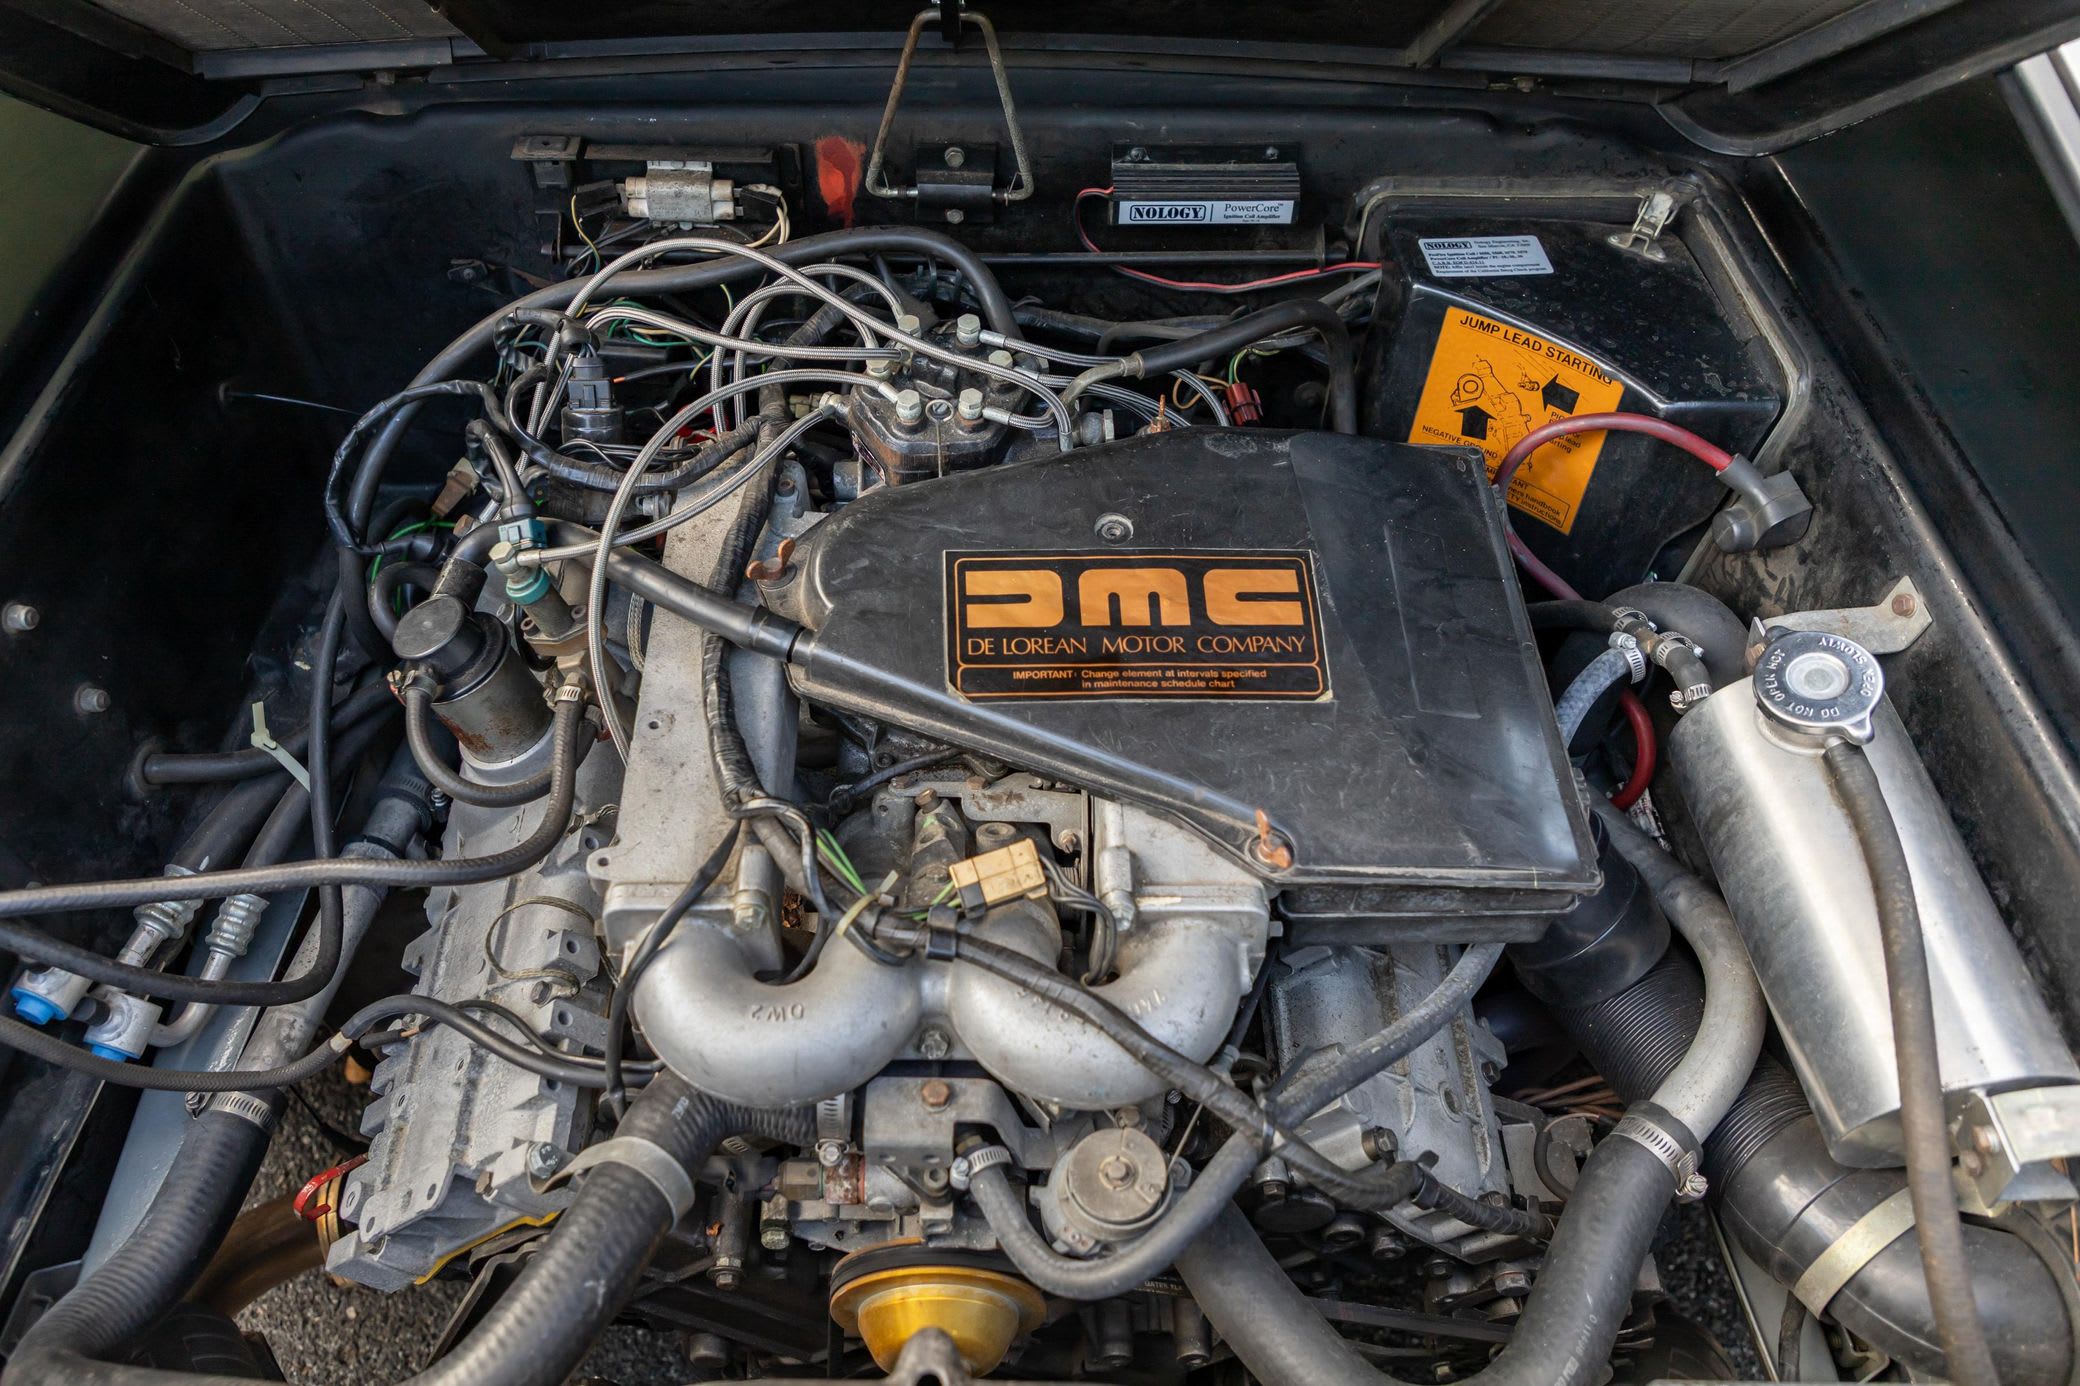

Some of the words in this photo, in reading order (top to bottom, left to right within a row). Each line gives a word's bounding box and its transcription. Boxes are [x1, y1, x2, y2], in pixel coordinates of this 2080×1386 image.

[1133, 207, 1202, 219] NOLOGY
[1426, 242, 1470, 250] NOLOGY
[1460, 315, 1500, 335] JUMP
[1503, 329, 1542, 352] LEAD
[1545, 346, 1614, 386] STARTING
[1422, 425, 1462, 444] NEGATIVE
[1520, 500, 1562, 525] instructions
[1525, 493, 1561, 516] handbook
[967, 637, 996, 656] DE
[1002, 637, 1087, 655] LOREAN
[1102, 636, 1186, 654] MOTOR
[1197, 635, 1306, 654] COMPANY
[1818, 636, 1868, 665] SLOWLY
[1081, 670, 1120, 679] Change
[1121, 669, 1162, 678] element
[1165, 669, 1175, 678] at
[1177, 669, 1219, 678] intervals
[1221, 669, 1267, 679] specified
[1081, 680, 1092, 688] in
[1093, 680, 1158, 689] maintenance
[1161, 679, 1207, 688] schedule
[1208, 680, 1236, 689] chart
[1764, 673, 1785, 702] OPEN
[1785, 701, 1814, 718] NOT
[1820, 706, 1841, 718] DO
